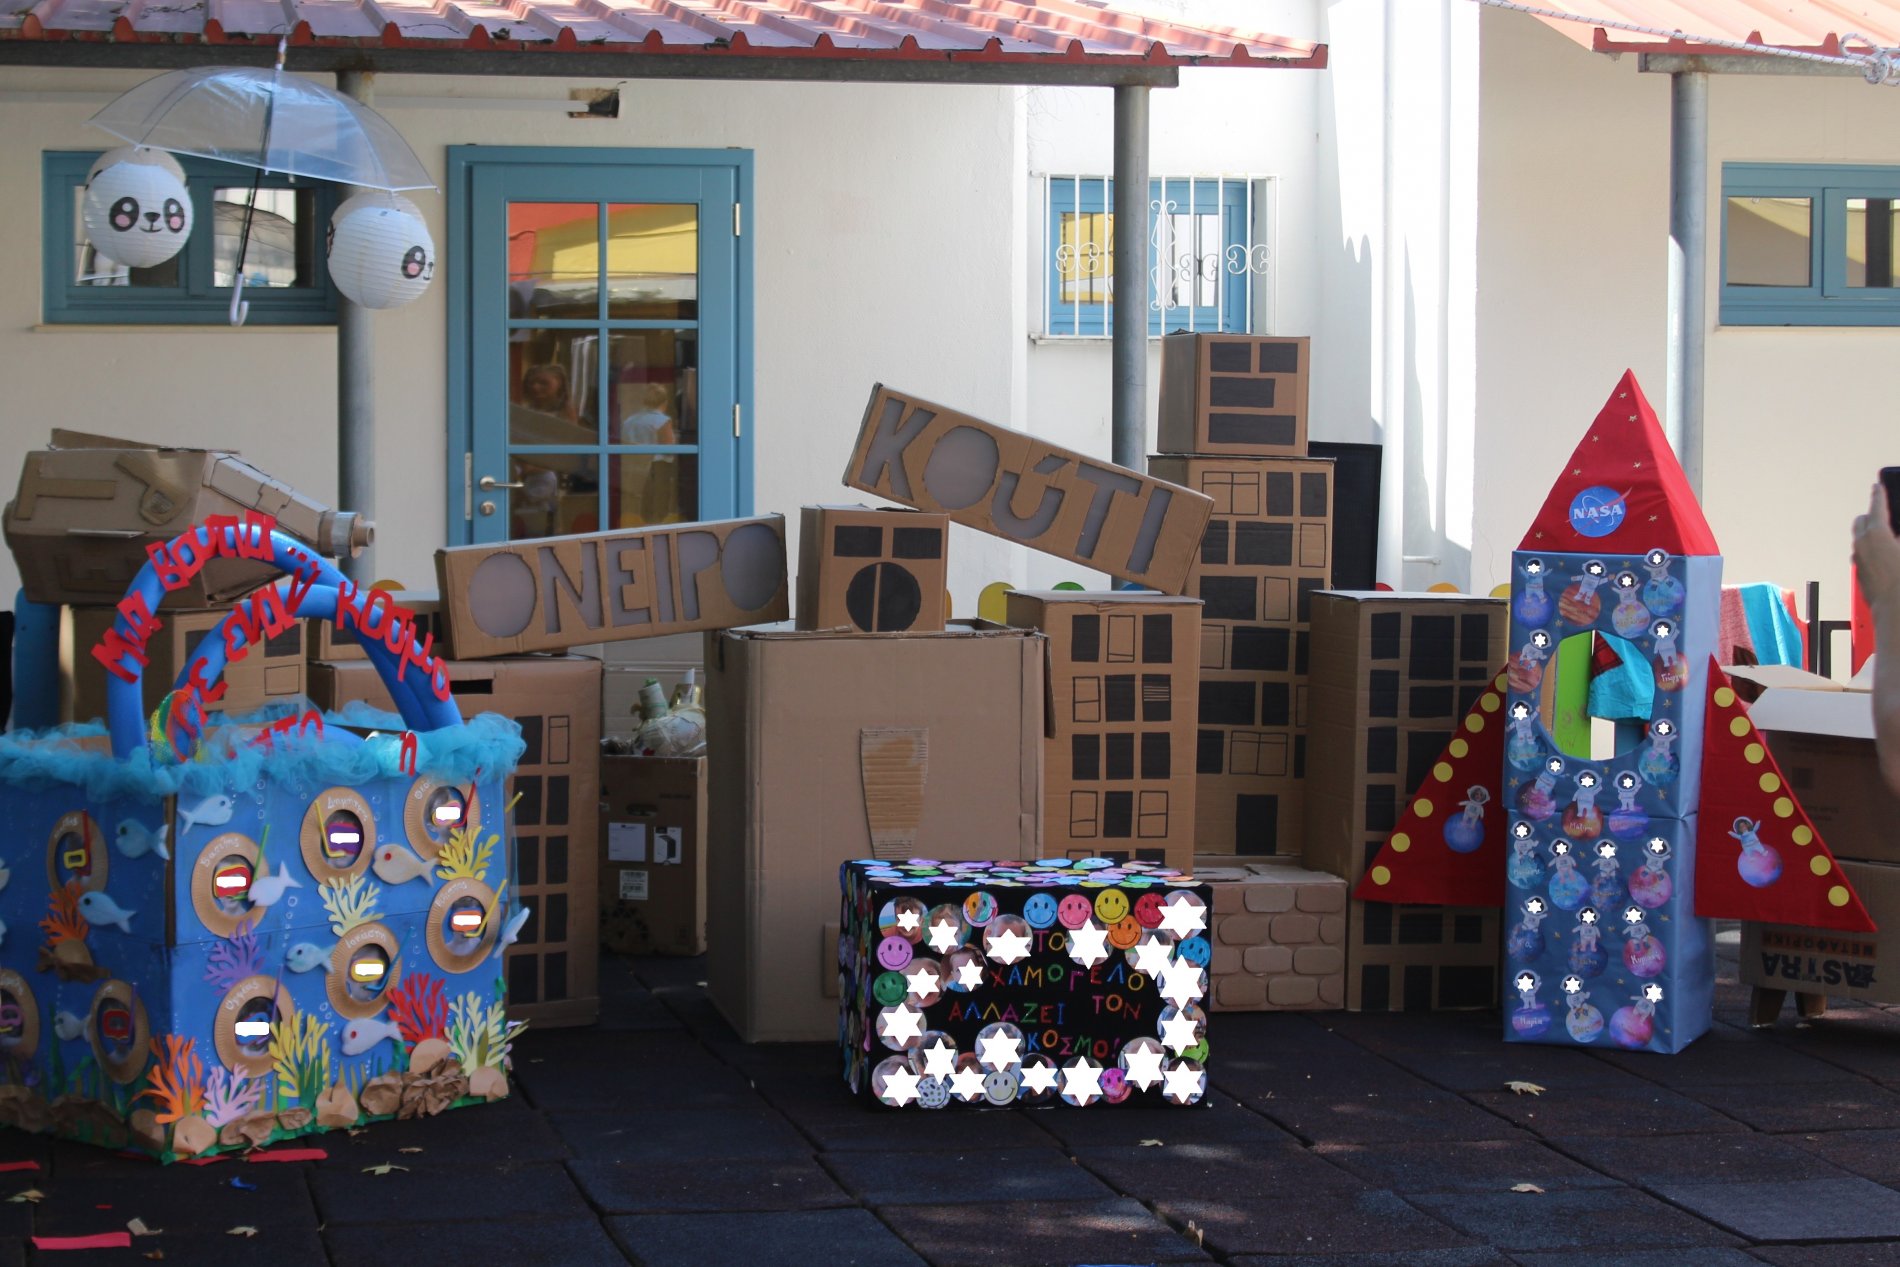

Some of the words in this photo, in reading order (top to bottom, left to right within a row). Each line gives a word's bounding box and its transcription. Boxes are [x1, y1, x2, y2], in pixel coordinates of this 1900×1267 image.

[1574, 505, 1623, 519] NASA
[468, 522, 783, 638] ΟΝΕΙΡΟ
[1033, 930, 1066, 954] ΤΟ
[990, 962, 1145, 993] ΧΑΜΟΓΕΛΟ
[948, 1001, 1065, 1024] ΑΛΛΑΖΕΙ
[1092, 993, 1141, 1019] ΤΟΝ
[1027, 1028, 1121, 1059] ΚΟΣΜΟ!
